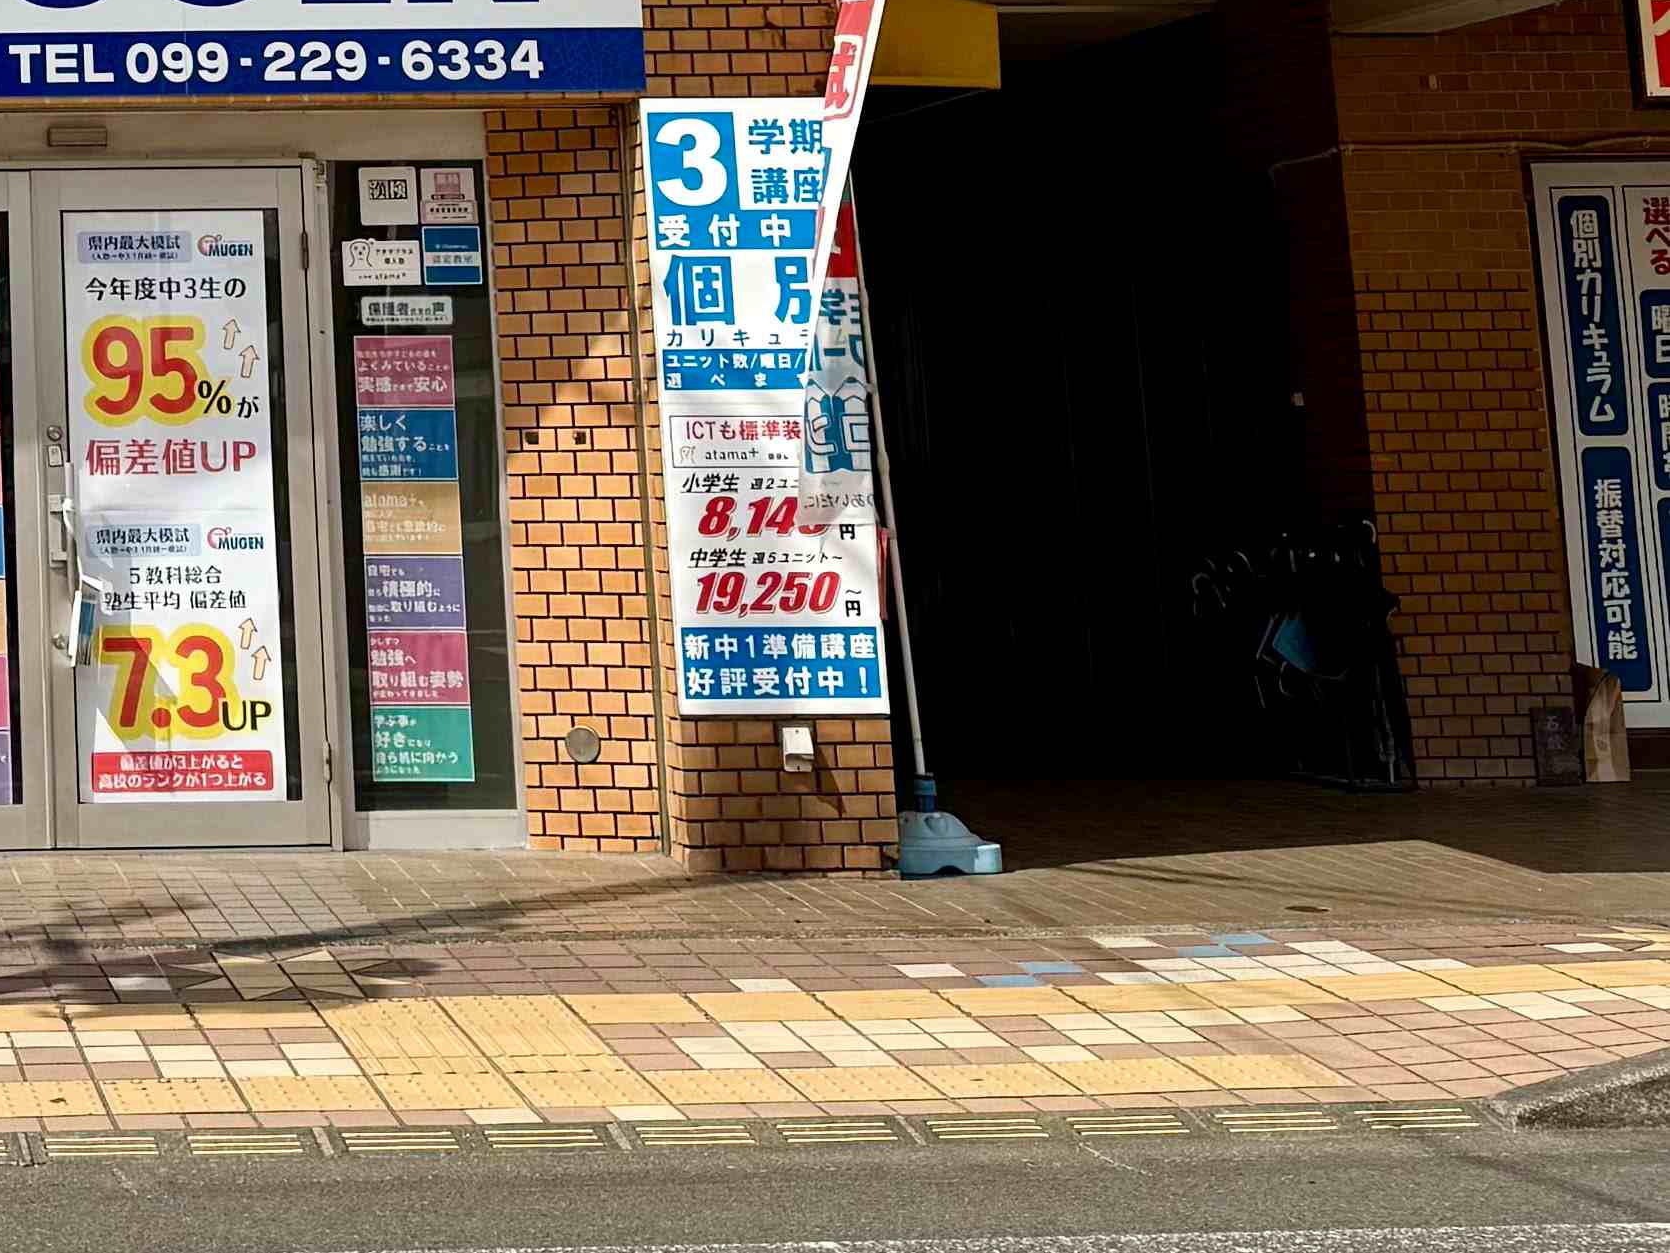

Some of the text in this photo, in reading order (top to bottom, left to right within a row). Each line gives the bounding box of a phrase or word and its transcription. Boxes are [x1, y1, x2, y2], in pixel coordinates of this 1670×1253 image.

[9, 44, 114, 84] TEL
[748, 118, 824, 155] 学期
[655, 118, 728, 207] 3
[751, 167, 823, 205] 講座
[658, 213, 792, 248] 受付中
[208, 243, 253, 257] MUGEN
[86, 277, 247, 301] 今年度中3生の
[1570, 209, 1615, 423] 個別カリキュラム
[682, 473, 739, 493] 小学生
[697, 495, 857, 541] 8,14 円
[217, 537, 265, 550] MUGEN
[689, 548, 747, 568] 中学生
[696, 571, 842, 617] 19,250
[101, 635, 272, 731] 7.3 UP
